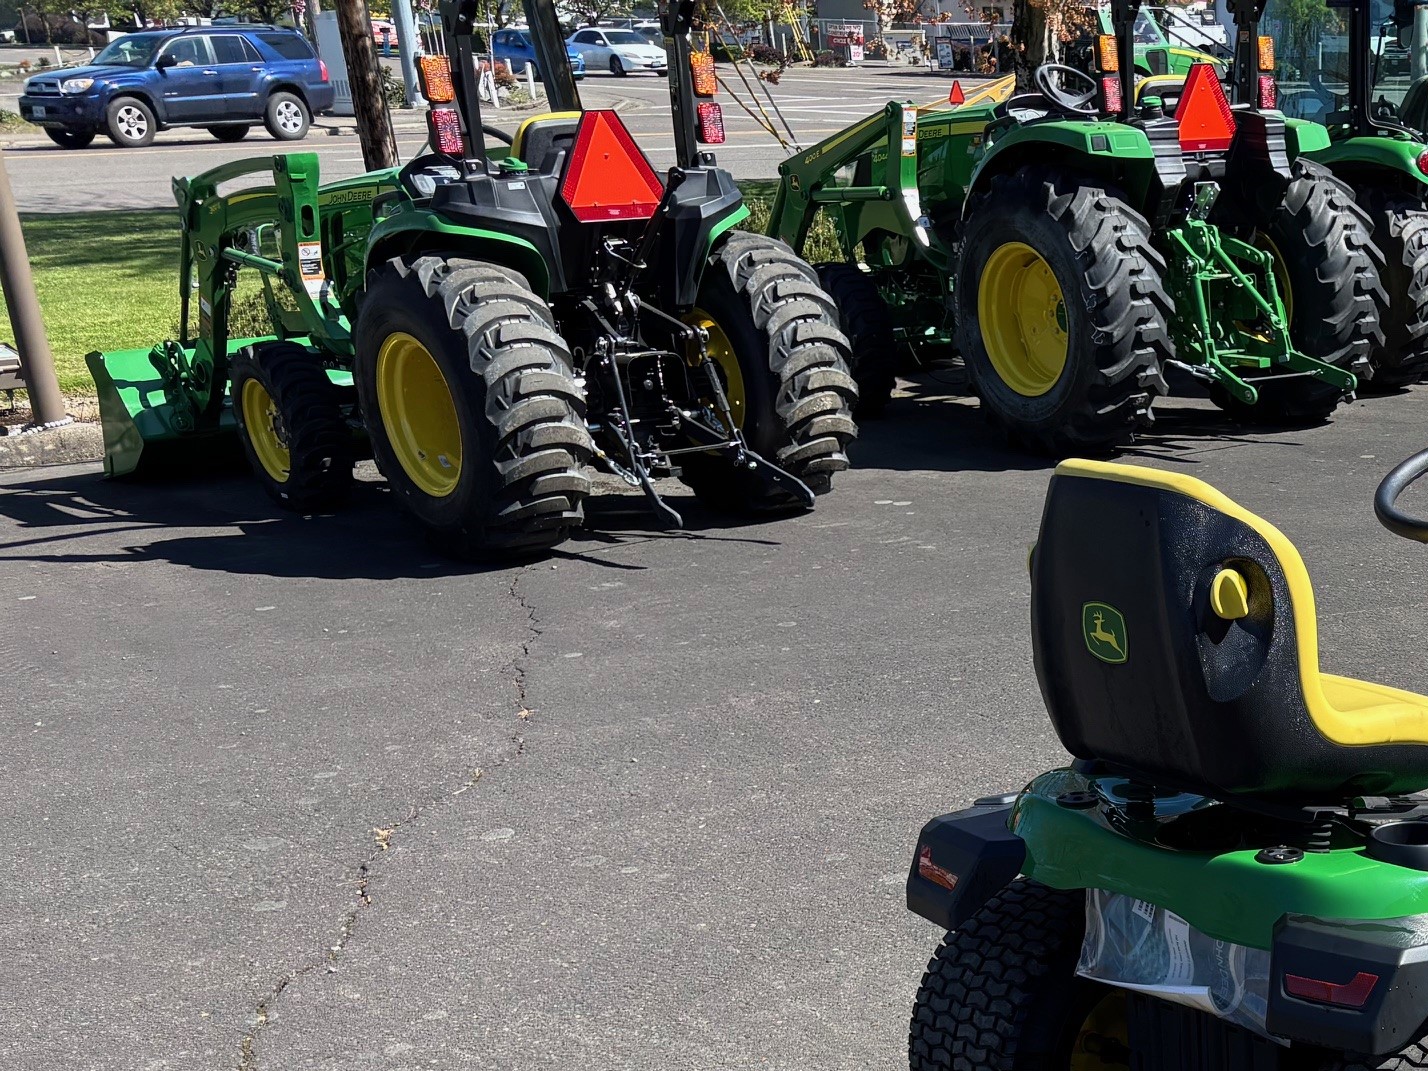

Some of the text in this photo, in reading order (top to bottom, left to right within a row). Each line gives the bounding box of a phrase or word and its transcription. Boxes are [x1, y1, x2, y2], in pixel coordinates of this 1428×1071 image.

[918, 128, 943, 139] DEERE
[804, 151, 821, 164] 400E
[329, 190, 372, 205] JOHN DEERE
[1215, 940, 1224, 967] OHN
